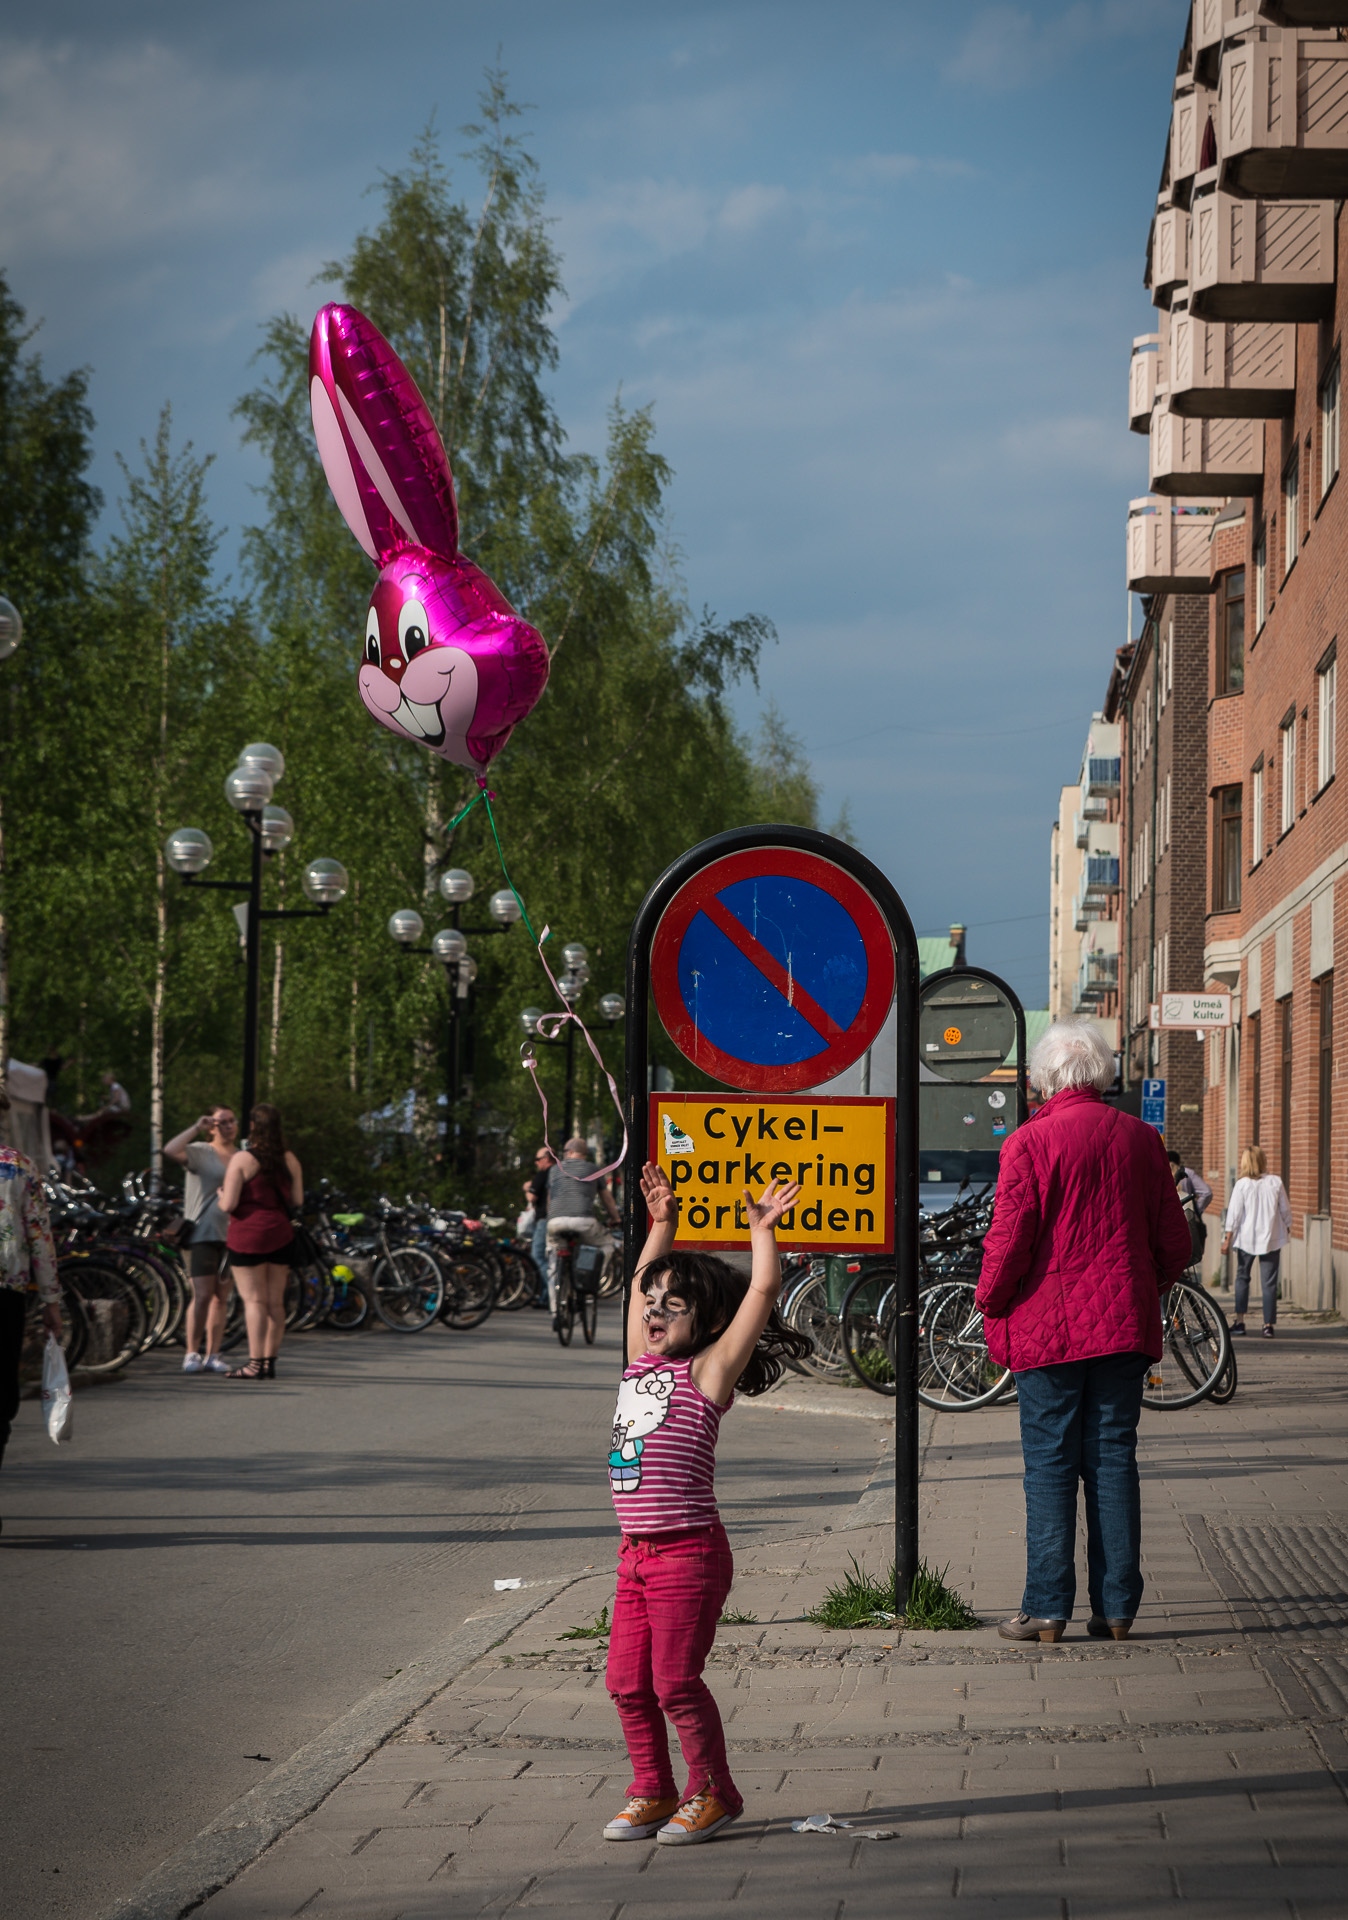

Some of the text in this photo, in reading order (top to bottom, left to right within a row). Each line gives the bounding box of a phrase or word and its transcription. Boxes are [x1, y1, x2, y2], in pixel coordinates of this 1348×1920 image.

[1193, 999, 1222, 1009] Umeå
[1193, 1010, 1224, 1020] Kultur
[1149, 1081, 1161, 1096] P
[703, 1107, 844, 1147] Cykel-
[671, 1153, 875, 1195] parkering
[675, 1196, 874, 1232] örbuden
